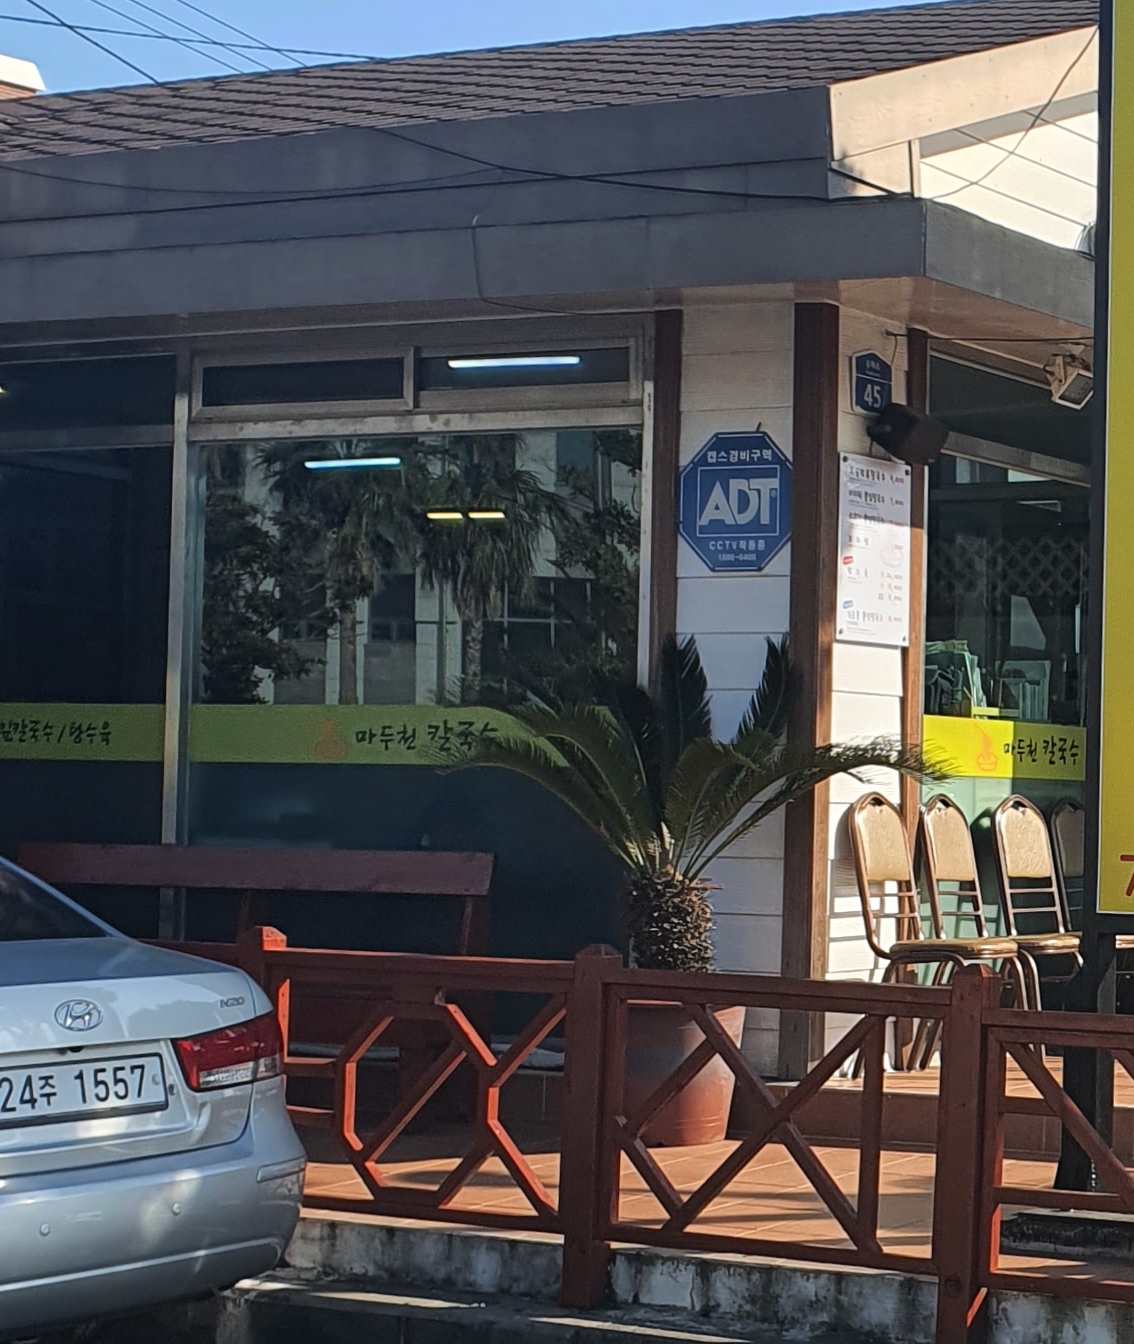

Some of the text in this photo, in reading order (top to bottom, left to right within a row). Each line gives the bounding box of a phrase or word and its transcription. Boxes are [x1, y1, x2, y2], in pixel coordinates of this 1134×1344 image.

[863, 383, 882, 408] 45
[699, 477, 779, 526] ADT
[355, 724, 417, 751] 마두천
[1003, 735, 1080, 766] 마두천 칼국수
[0, 1063, 146, 1113] 24주 1557
